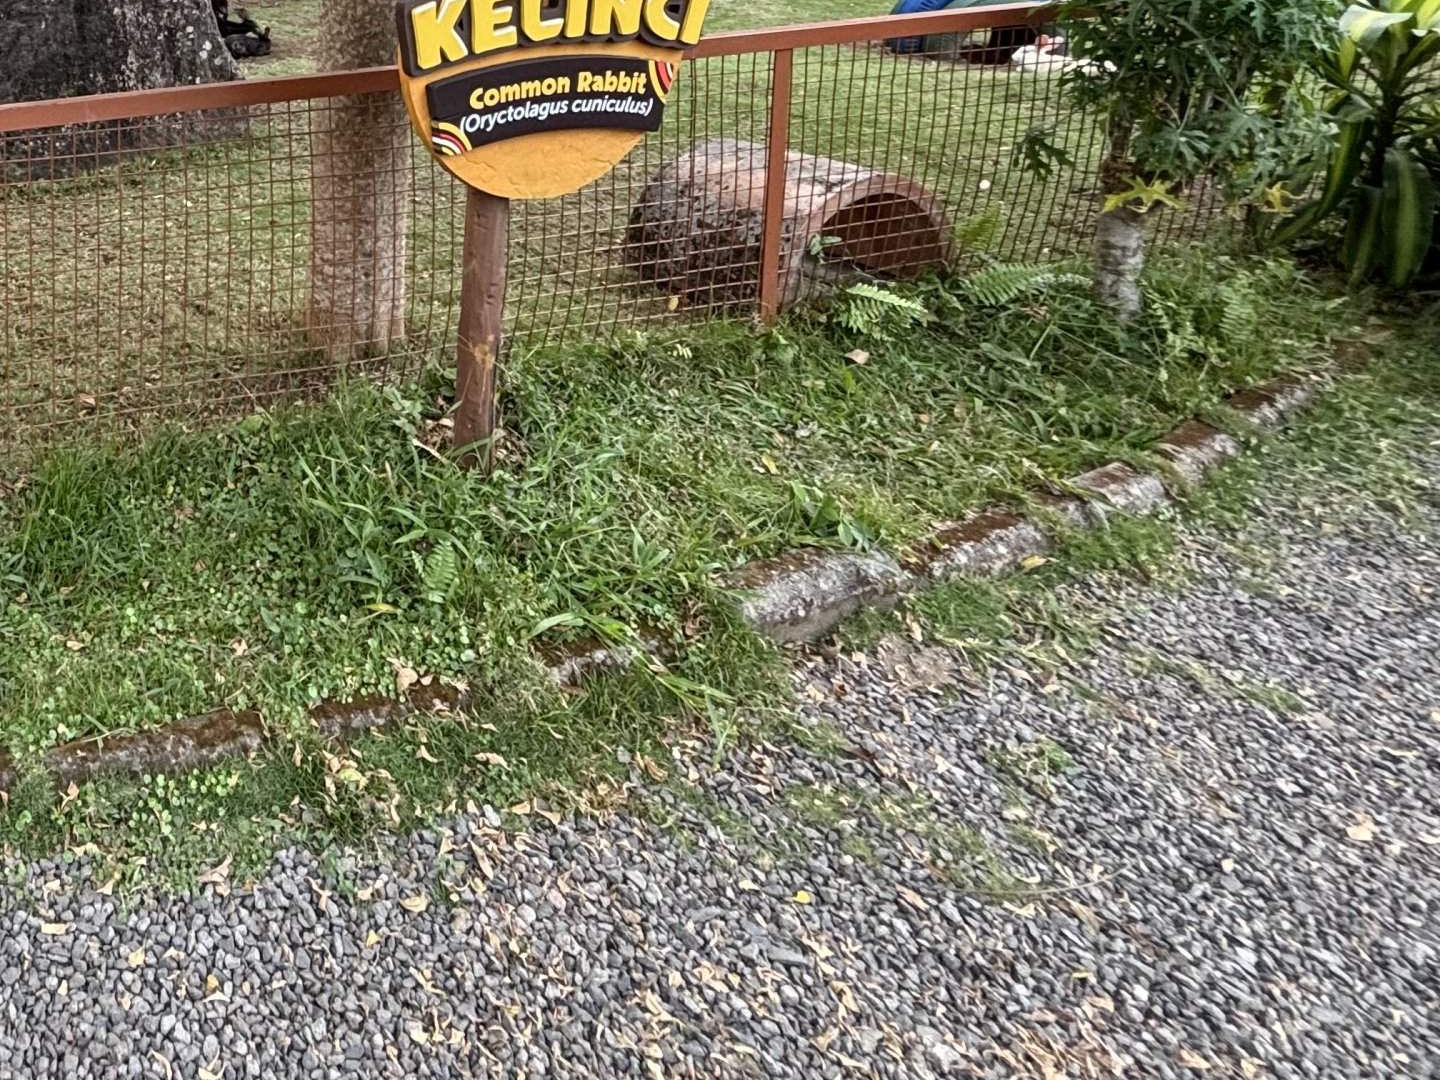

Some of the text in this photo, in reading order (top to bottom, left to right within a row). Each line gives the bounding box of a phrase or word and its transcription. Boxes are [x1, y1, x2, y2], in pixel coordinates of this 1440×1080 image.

[469, 71, 647, 110] Common Rabbit
[459, 94, 654, 134] (Oryctolagus cuniculus)
